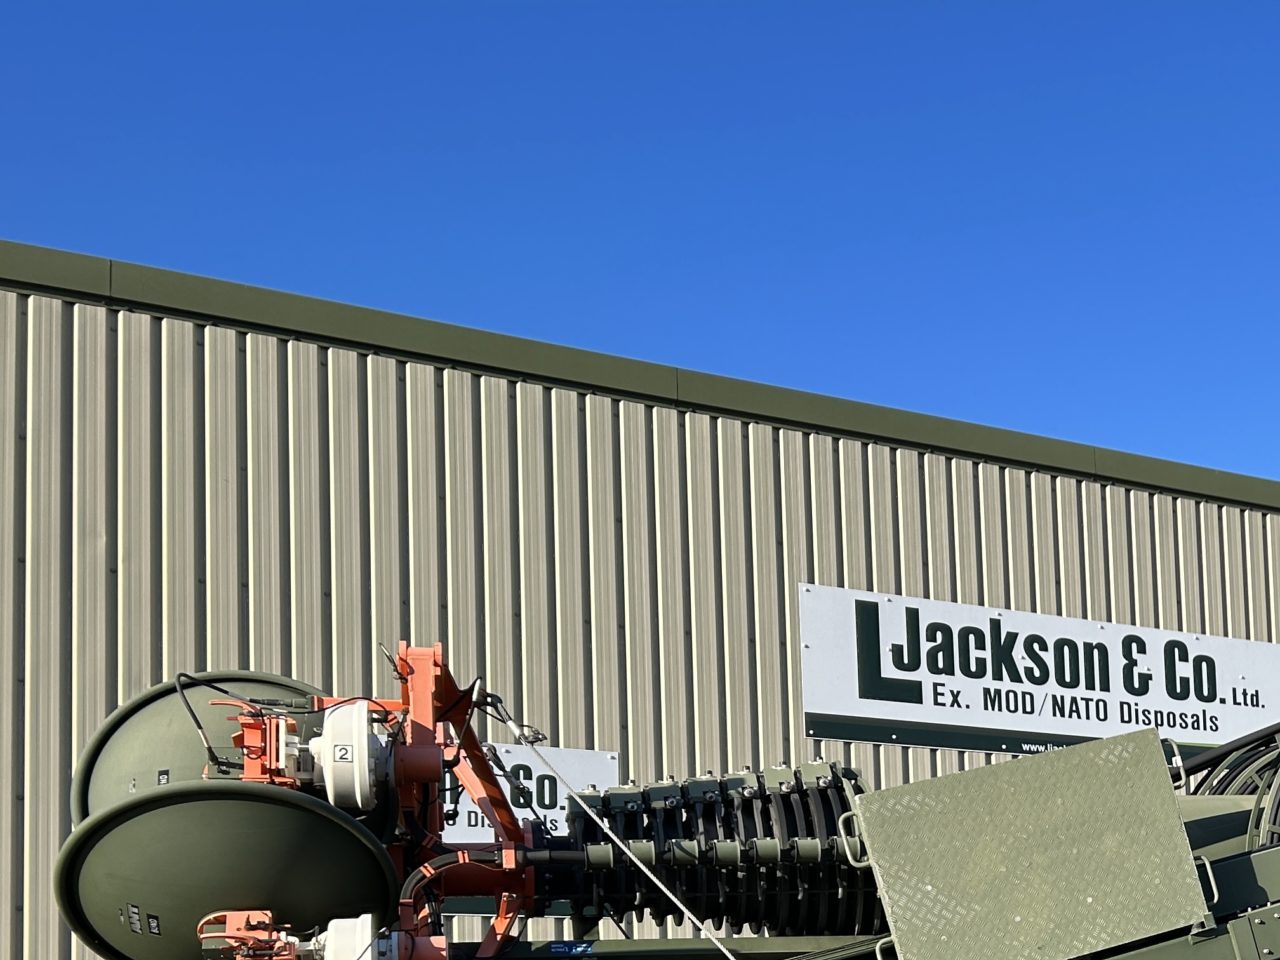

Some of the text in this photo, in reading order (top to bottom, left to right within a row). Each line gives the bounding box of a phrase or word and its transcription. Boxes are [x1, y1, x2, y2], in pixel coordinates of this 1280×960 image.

[891, 606, 1111, 693] Jackson
[1121, 634, 1153, 697] &
[1163, 639, 1227, 704] Co.
[1232, 687, 1266, 709] Ltd.
[932, 681, 1219, 732] Ex. MOD/NATO Disposals
[338, 747, 349, 760] 2
